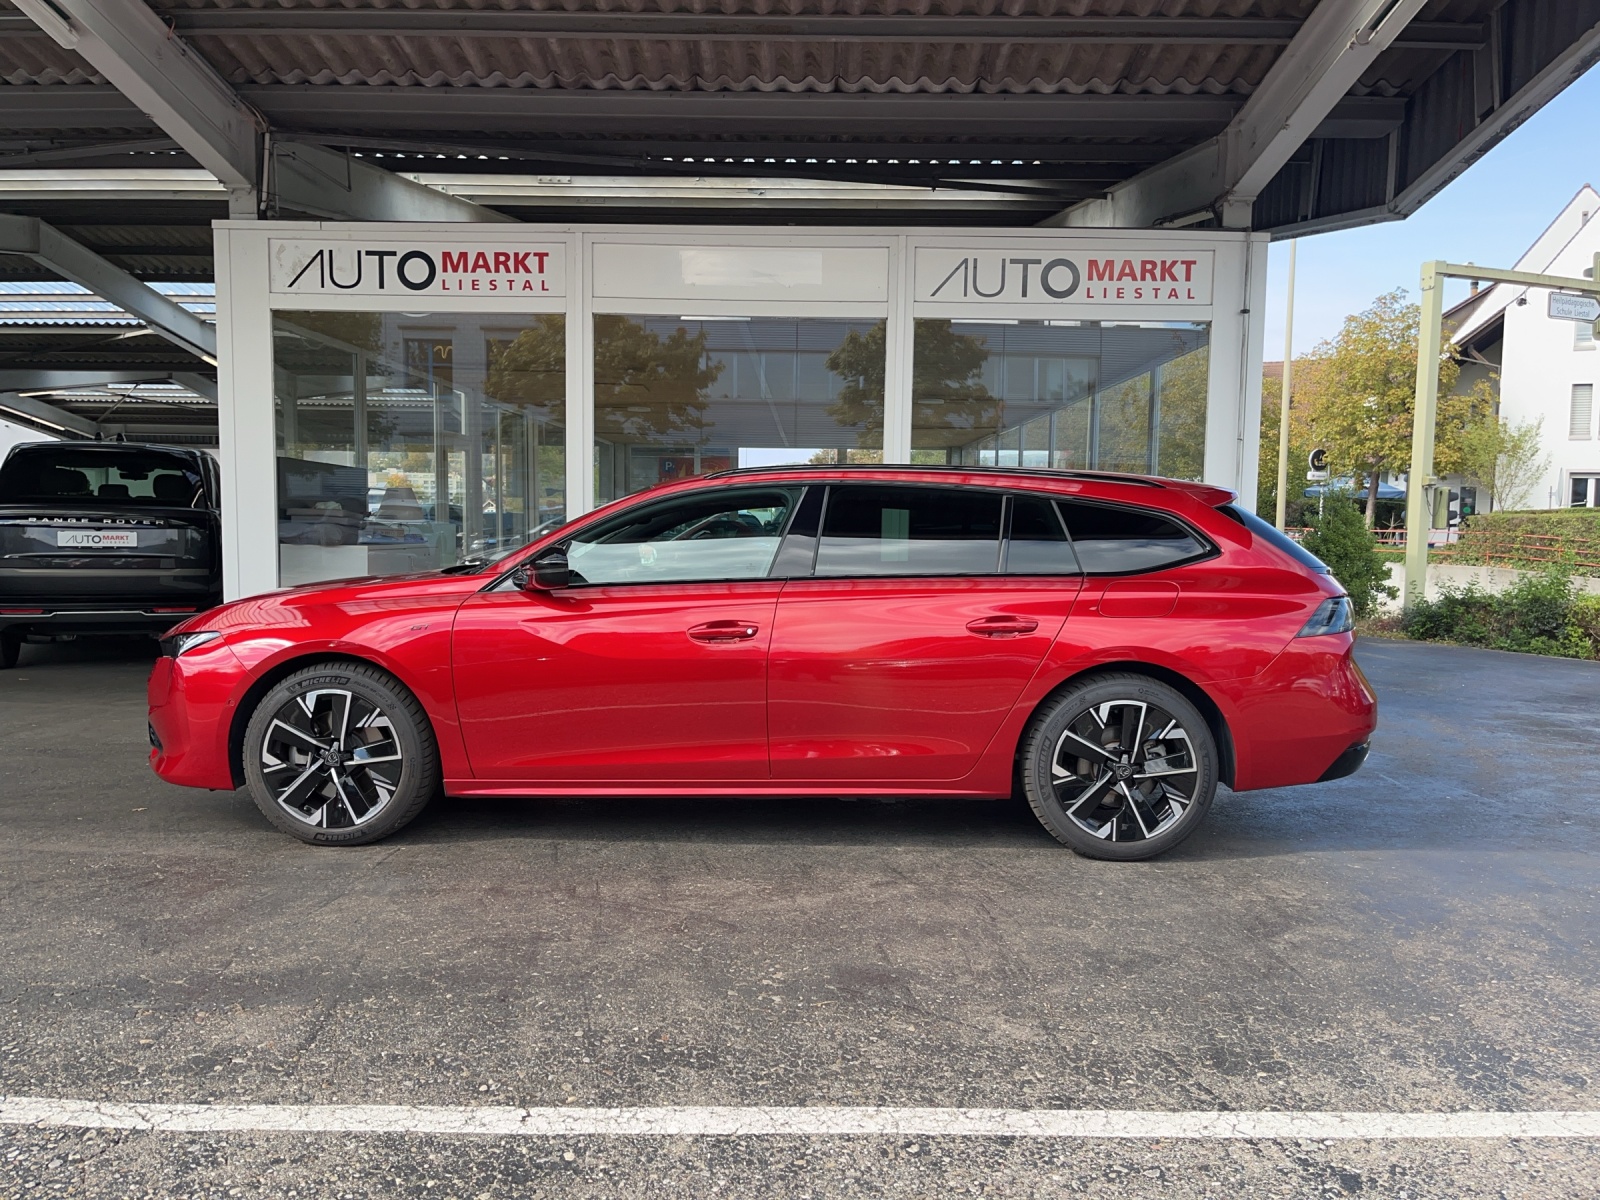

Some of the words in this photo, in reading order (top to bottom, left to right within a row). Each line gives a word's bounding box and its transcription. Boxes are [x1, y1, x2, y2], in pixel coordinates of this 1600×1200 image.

[287, 249, 436, 291] AUTO
[441, 251, 549, 274] MARKT
[930, 257, 1081, 299] AUTO
[1087, 259, 1197, 282] MARKT
[442, 279, 549, 291] LIESTAL
[1086, 287, 1195, 299] LIESTAL
[1556, 306, 1573, 316] Schule
[1574, 309, 1590, 318] Liestal
[65, 534, 102, 544] AUTO
[301, 676, 350, 687] MICHELIN
[1039, 736, 1052, 787] MICHELIN
